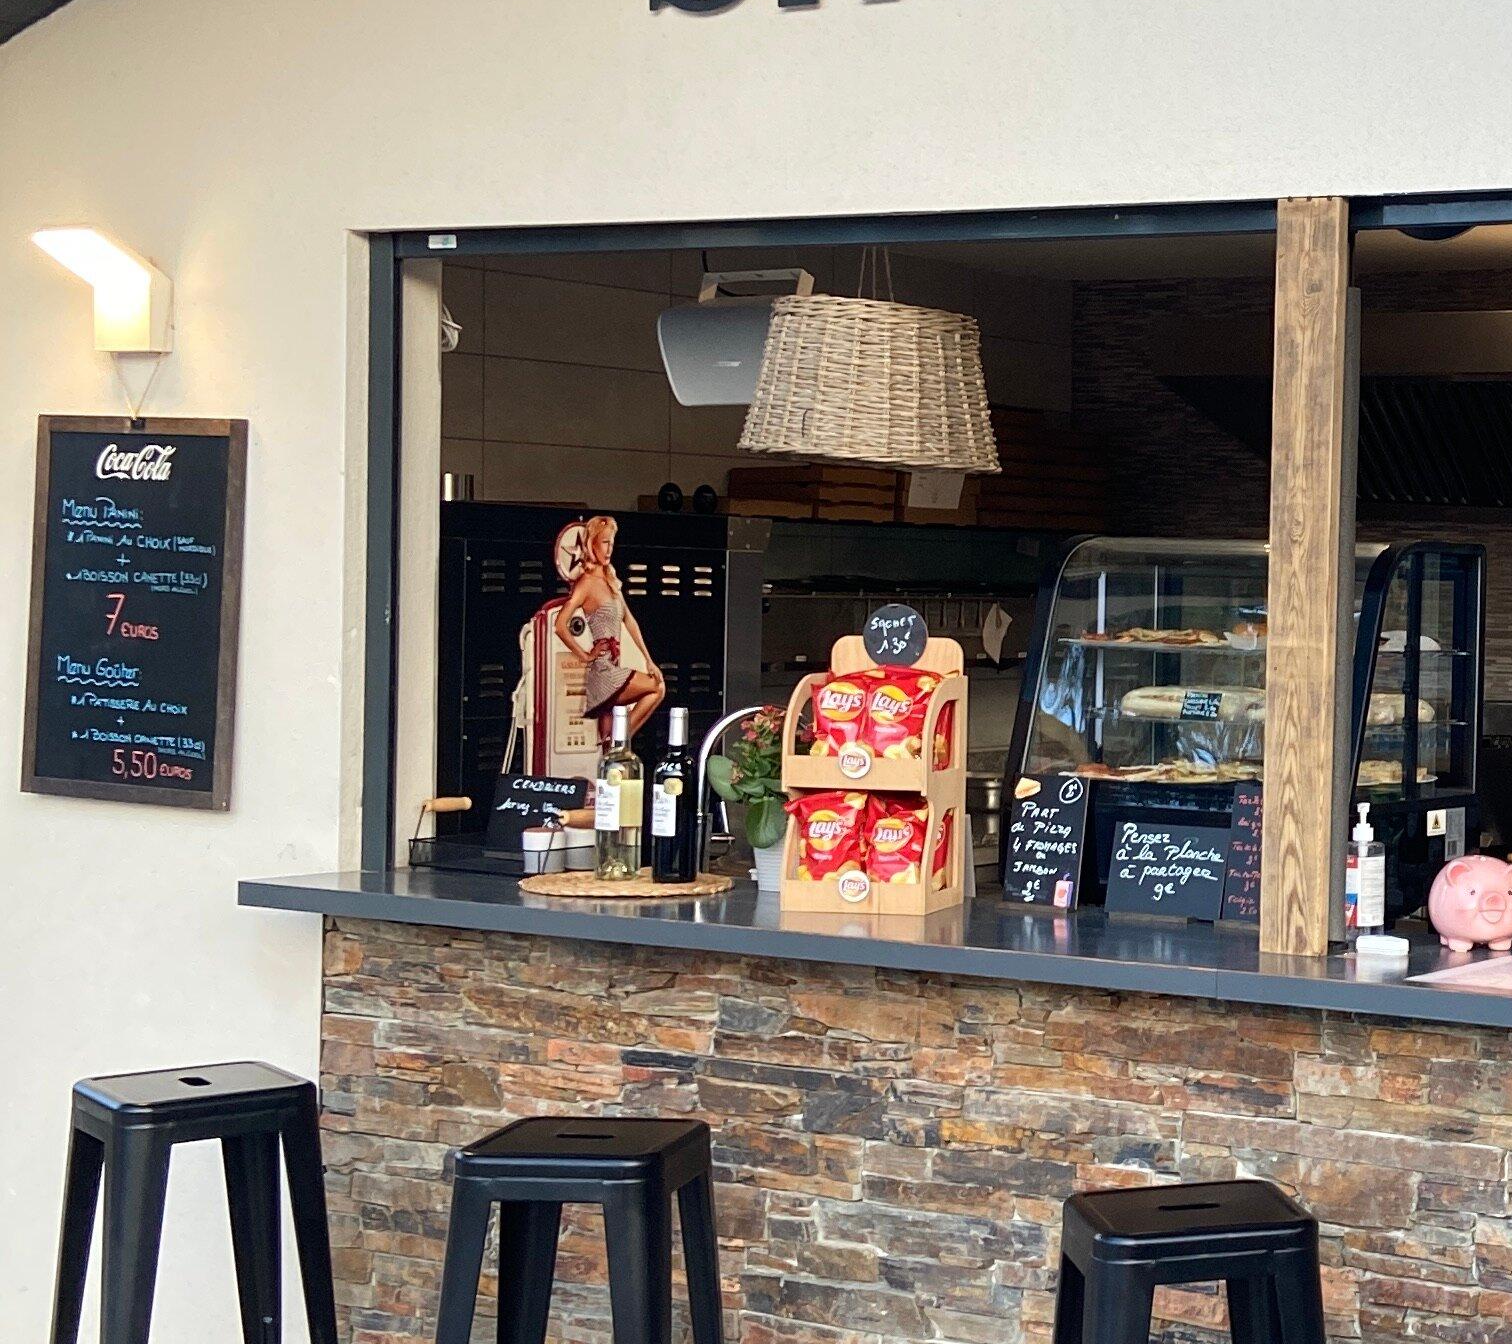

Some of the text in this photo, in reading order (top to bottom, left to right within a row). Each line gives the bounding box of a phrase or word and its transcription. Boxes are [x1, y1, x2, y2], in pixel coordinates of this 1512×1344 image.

[62, 498, 98, 518] Menu
[106, 593, 126, 635] 7
[57, 655, 91, 675] Menu
[112, 748, 157, 779] 5,50
[1021, 801, 1060, 819] PART
[1121, 822, 1171, 844] Pensez
